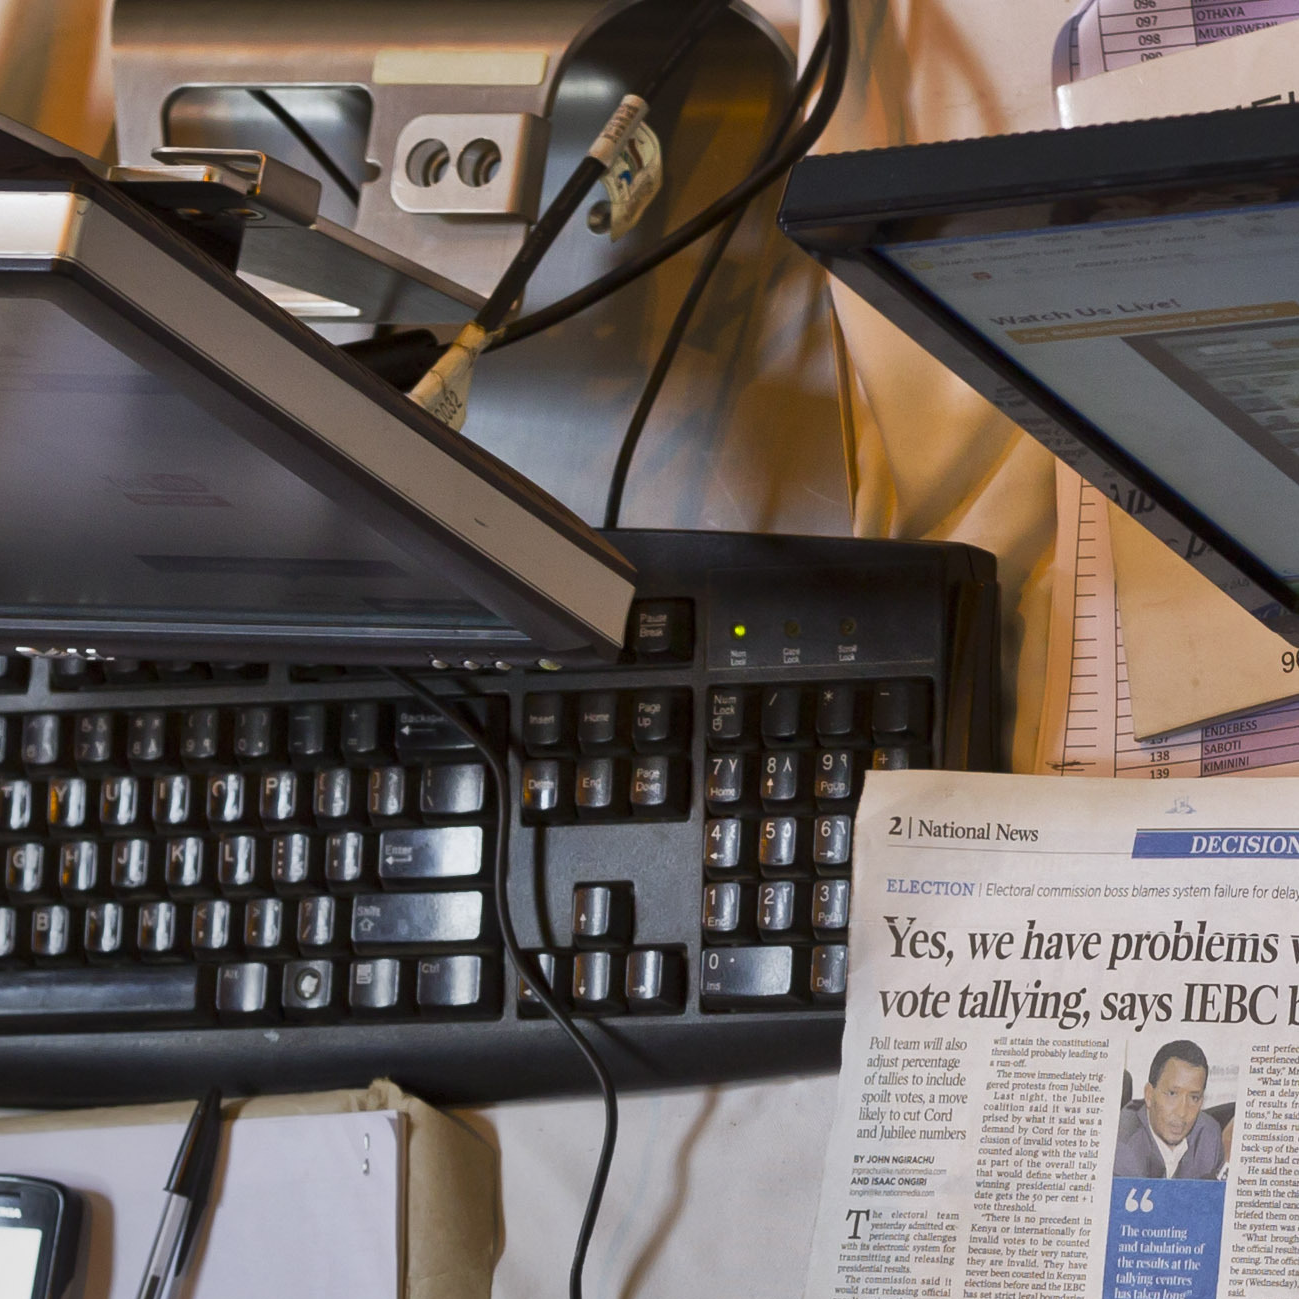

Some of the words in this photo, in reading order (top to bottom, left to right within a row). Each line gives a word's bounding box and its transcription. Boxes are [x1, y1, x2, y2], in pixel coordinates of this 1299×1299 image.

[1136, 16, 1157, 28] 097
[1196, 6, 1245, 21] OTHAYA
[1139, 34, 1161, 46] 098
[989, 308, 1071, 327] Watch
[1076, 302, 1112, 317] Us
[713, 695, 736, 704] Num
[584, 712, 610, 722] Home
[713, 705, 735, 715] Lock
[529, 715, 554, 724] Insert
[638, 717, 651, 727] Up
[1205, 720, 1258, 738] ENDEBESS
[1150, 750, 1170, 762] 138
[1204, 740, 1241, 755] SABOTI
[713, 759, 723, 775] 7
[767, 757, 776, 774] 8
[822, 754, 833, 770] 9
[1150, 768, 1170, 779] 139
[1204, 756, 1250, 773] KIMININI
[820, 781, 845, 793] PgUp
[711, 825, 721, 841] 4
[766, 823, 776, 839] 5
[821, 821, 831, 837] 6
[888, 816, 902, 835] 2
[918, 820, 990, 840] National
[996, 823, 1038, 842] News
[765, 888, 774, 905] 2
[820, 885, 829, 902] 3
[886, 879, 975, 896] ELECTION
[986, 883, 1034, 897] Electoral
[1037, 884, 1101, 898] commission
[1104, 885, 1128, 898] boss
[1132, 885, 1170, 898] blames
[1172, 886, 1210, 899] system
[1214, 885, 1249, 898] failure
[1252, 885, 1269, 899] for
[883, 916, 954, 967] Yes,
[968, 931, 1014, 960] we
[1020, 920, 1101, 960] have
[1106, 920, 1279, 970] problems
[421, 963, 440, 973] Ctrl
[709, 953, 719, 970] 0
[879, 982, 951, 1018] vote
[958, 979, 1090, 1029] tallying,
[1101, 991, 1172, 1032] says
[1181, 983, 1279, 1025] IEBC
[869, 1036, 890, 1050] Poll
[893, 1037, 920, 1050] team
[924, 1037, 943, 1050] will
[945, 1037, 967, 1050] also
[867, 1054, 898, 1071] adjust
[901, 1058, 960, 1071] percentage
[864, 1072, 877, 1085] of
[878, 1072, 908, 1085] tallies
[912, 1074, 923, 1085] to
[926, 1073, 966, 1086] include
[862, 1090, 891, 1106] spoilt
[895, 1091, 925, 1104] votes,
[929, 1094, 935, 1104] a
[938, 1094, 968, 1104] move
[993, 1092, 1014, 1100] Last
[1052, 1093, 1067, 1102] the
[1072, 1094, 1105, 1104] Jubilee
[859, 1107, 886, 1124] likely
[890, 1109, 900, 1120] to
[903, 1109, 921, 1121] cut
[924, 1108, 953, 1121] Cord
[857, 1125, 877, 1138] and
[879, 1125, 916, 1141] Jubilee
[919, 1126, 966, 1140] numbers
[853, 1155, 865, 1163] BY
[867, 1156, 890, 1164] JOHN
[892, 1156, 935, 1164] NGIRACHU
[898, 1178, 927, 1186] ONGIRI
[1121, 1225, 1139, 1237] The
[1142, 1226, 1188, 1241] counting
[1119, 1241, 1138, 1252] and
[1140, 1242, 1191, 1254] tabulation
[1194, 1243, 1206, 1254] of
[1117, 1256, 1134, 1268] the
[1136, 1257, 1169, 1270] results
[1171, 1259, 1181, 1270] at
[1184, 1259, 1200, 1270] the
[1116, 1272, 1153, 1286] tallying
[1155, 1275, 1192, 1286] centres
[1114, 1288, 1131, 1299] has
[1133, 1288, 1160, 1299] taken
